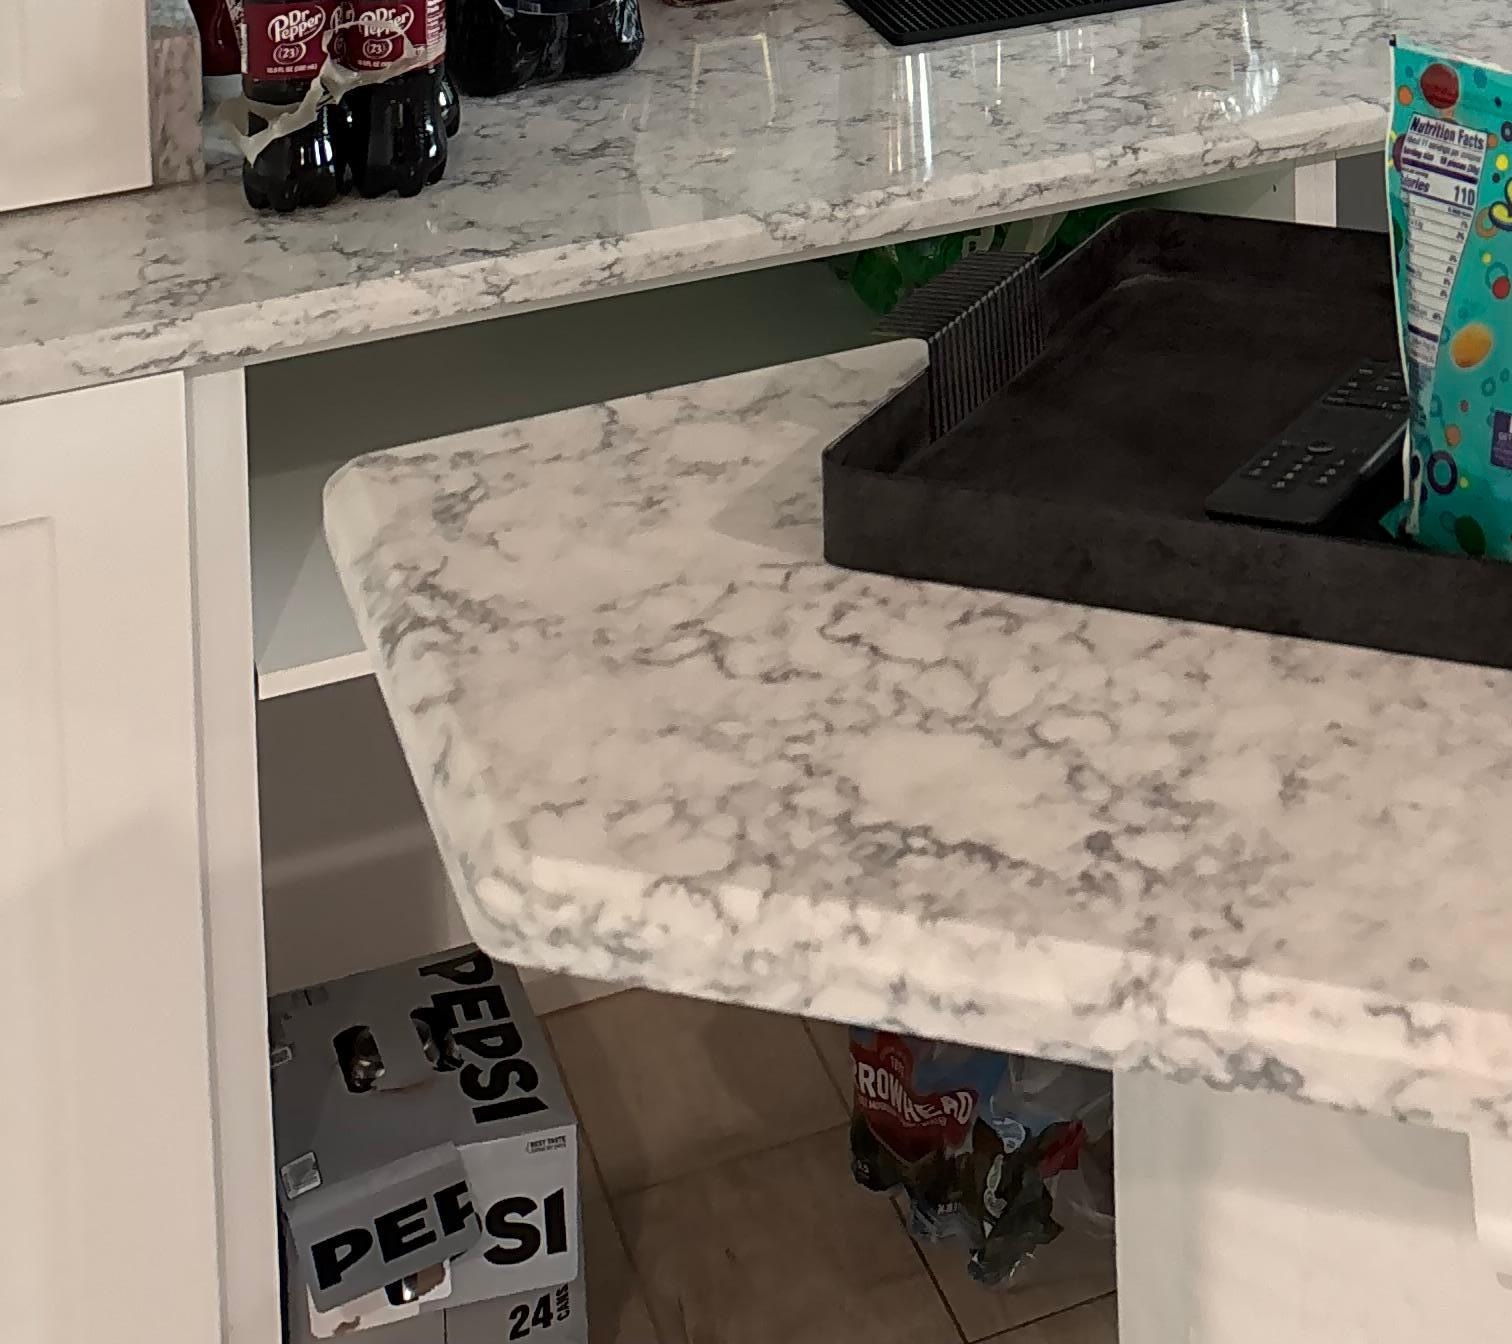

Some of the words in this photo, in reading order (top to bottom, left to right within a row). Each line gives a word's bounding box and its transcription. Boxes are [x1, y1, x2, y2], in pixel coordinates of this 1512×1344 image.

[267, 13, 322, 43] Pepper
[289, 9, 310, 26] Dr
[1410, 116, 1456, 142] Nutrition
[1458, 128, 1484, 150] Facts
[1454, 184, 1476, 206] 110
[418, 951, 550, 1125] PEPSI
[508, 1293, 554, 1342] 24
[556, 1282, 571, 1322] CANS
